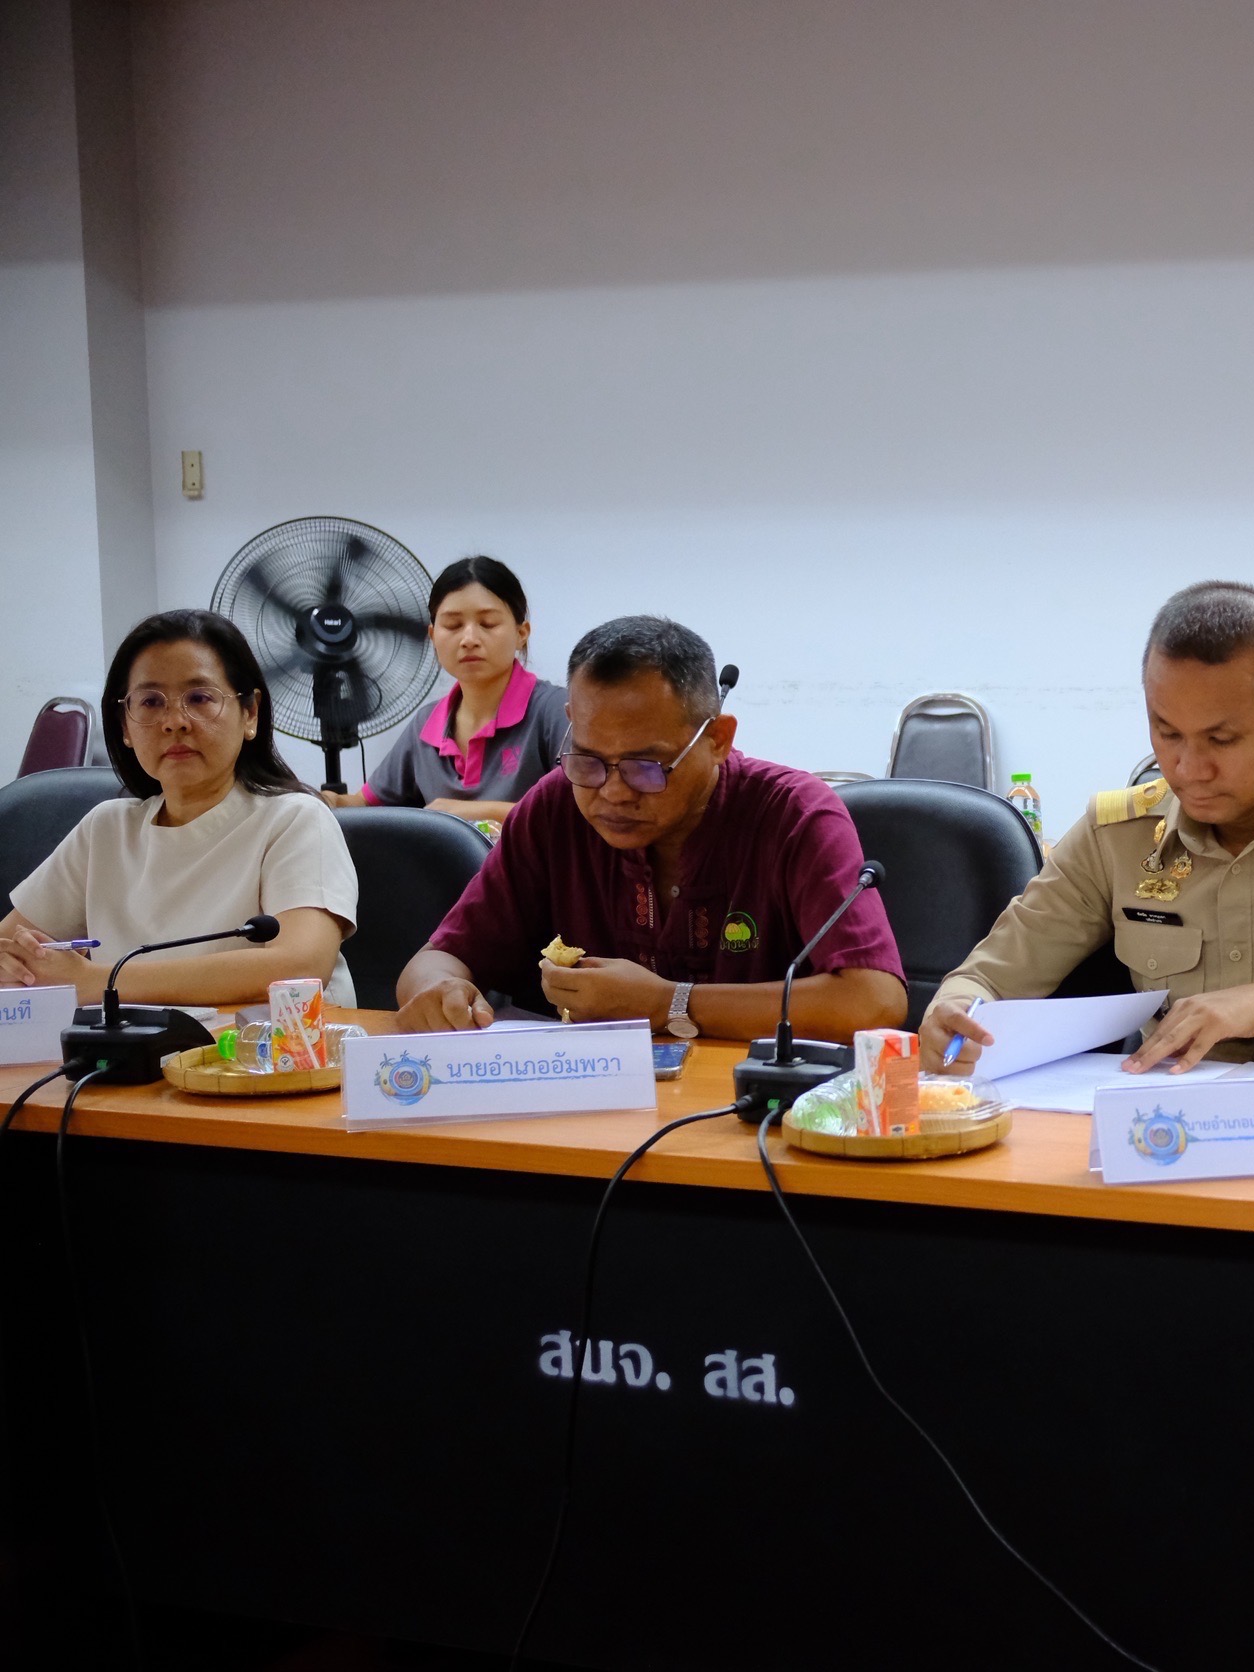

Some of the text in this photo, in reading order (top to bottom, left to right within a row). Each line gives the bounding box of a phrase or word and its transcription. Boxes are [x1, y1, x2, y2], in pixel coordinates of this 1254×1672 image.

[0, 998, 32, 1021] นที
[446, 1051, 622, 1078] นายอำเภออัมพวา
[539, 1329, 796, 1406] สนจ. สส.
